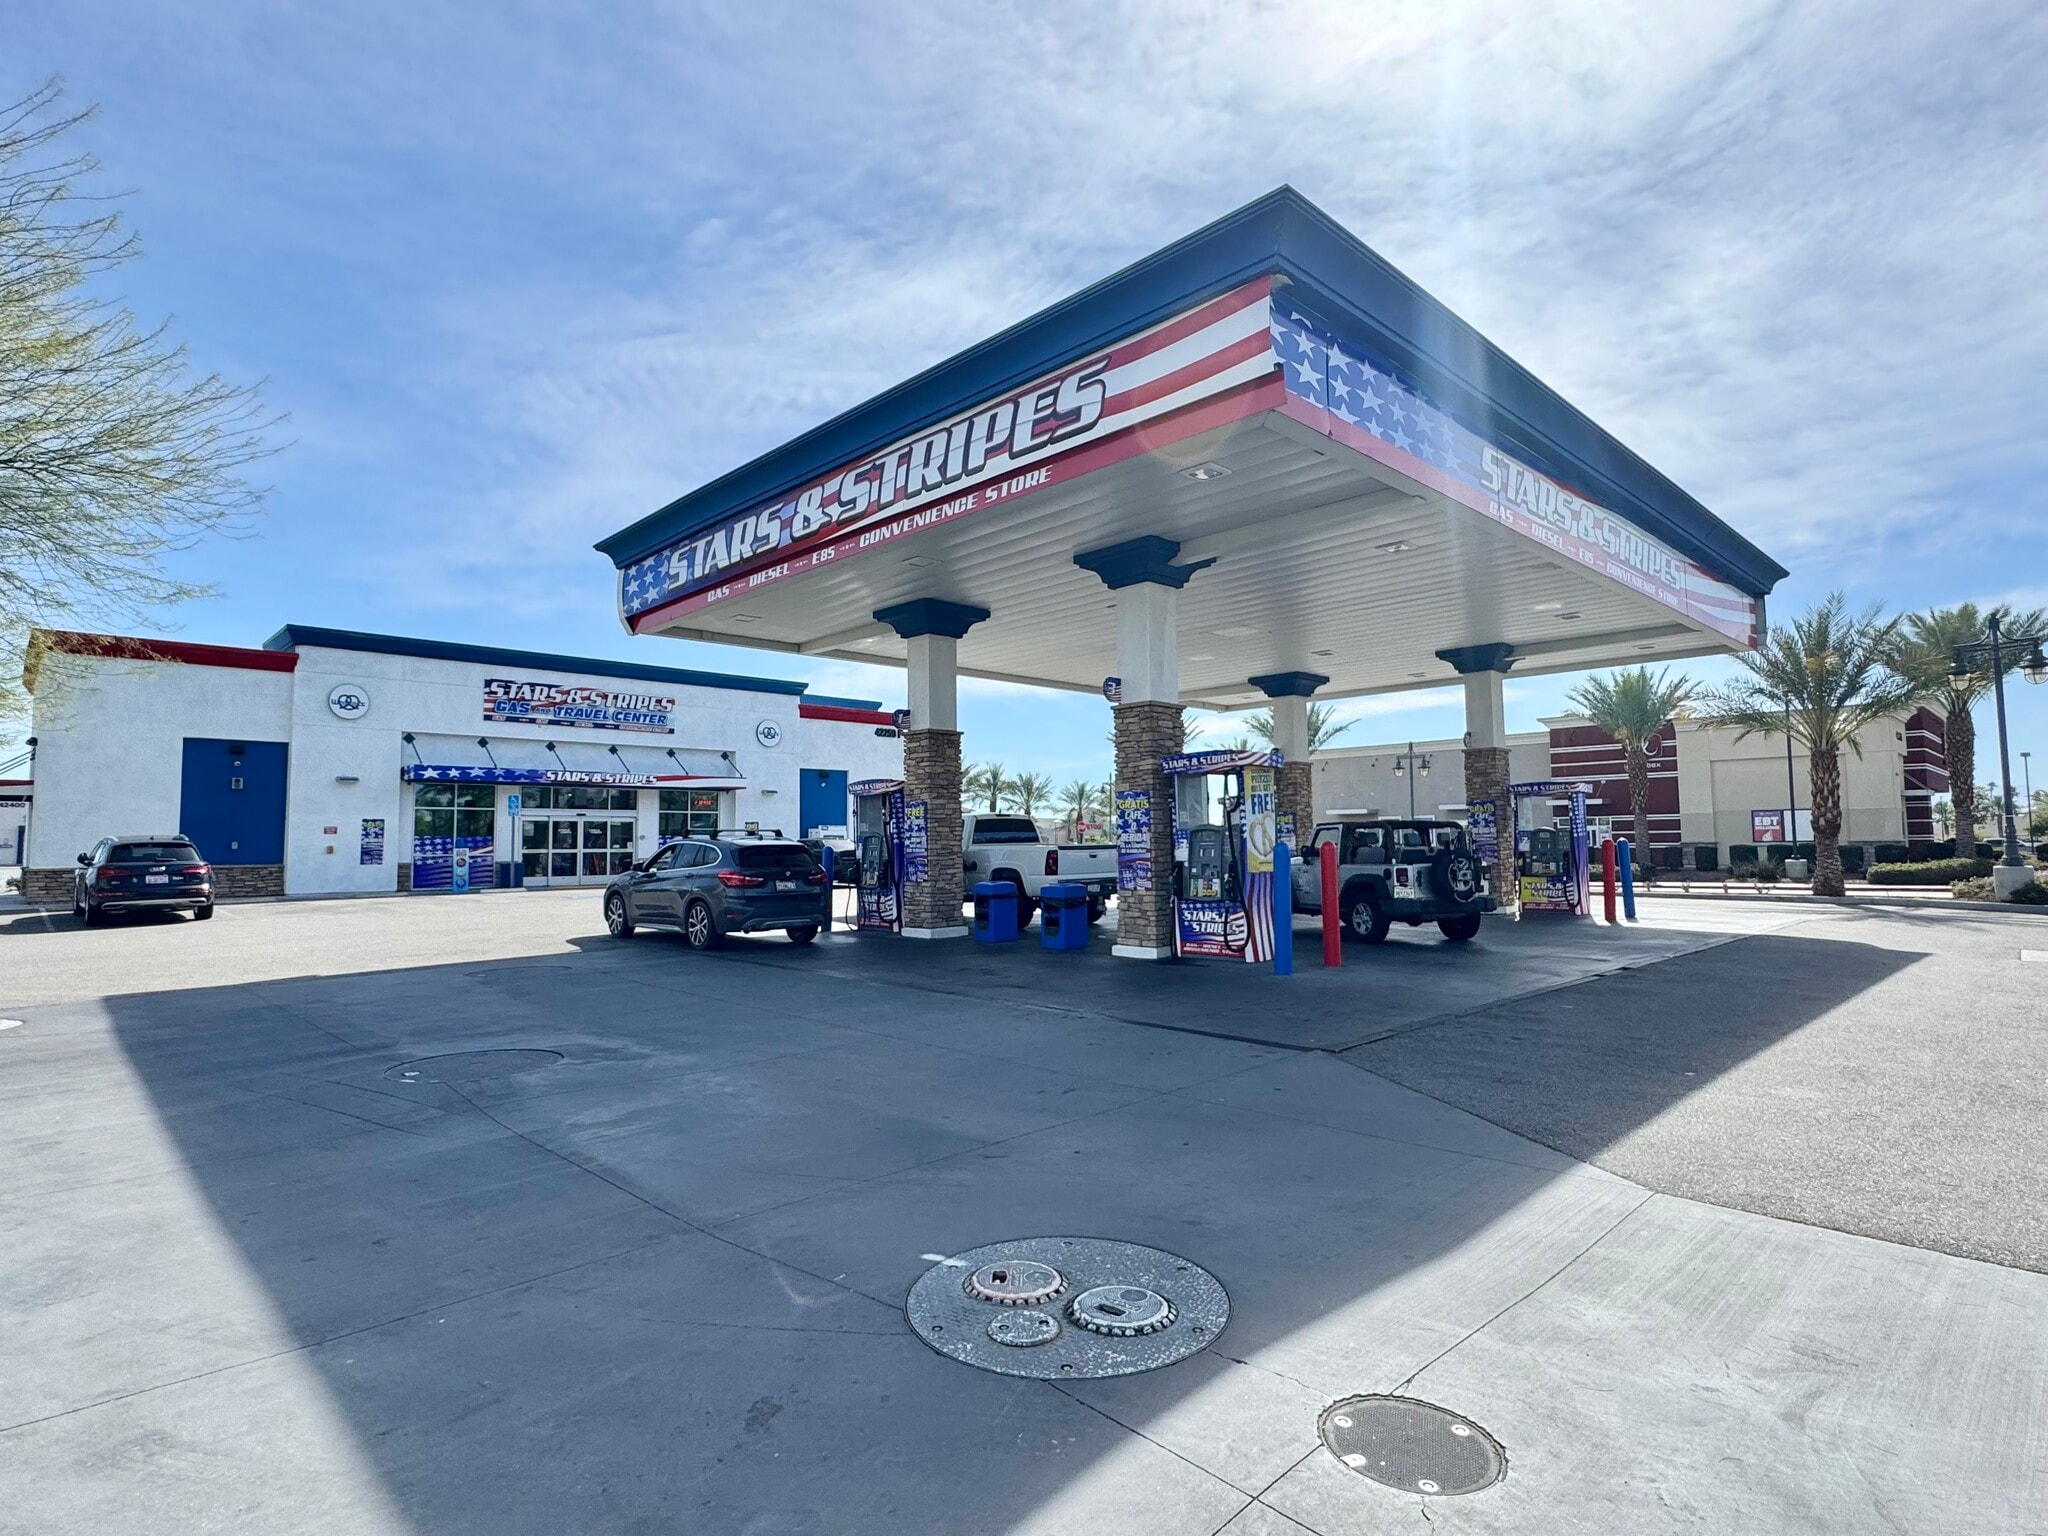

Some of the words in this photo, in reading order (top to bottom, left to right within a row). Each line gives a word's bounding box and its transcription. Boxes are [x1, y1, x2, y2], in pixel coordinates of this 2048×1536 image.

[667, 499, 785, 593] STARS
[791, 484, 831, 541] &
[837, 355, 1112, 527] STRIPES
[1480, 445, 1575, 536] STARS
[1578, 502, 1603, 546] &
[1602, 515, 1684, 591] STRIPES
[706, 583, 731, 604] GAS
[748, 562, 791, 589] DIESEL
[811, 544, 836, 567] E85
[858, 491, 980, 549] CONVENIENCE
[984, 464, 1053, 505] STORE
[1488, 500, 1514, 524] GAS
[1530, 522, 1566, 551] DIESEL
[1606, 560, 1657, 597] CONVENIENCE
[1657, 588, 1679, 608] STORE
[489, 681, 562, 704] STARS
[566, 688, 583, 705] &
[591, 690, 675, 713] STRIPES
[495, 700, 532, 715] GAS
[553, 705, 610, 721] TRAVEL
[612, 710, 668, 726] CENTER
[1162, 758, 1189, 770] STARS
[1190, 757, 1199, 767] &
[1200, 752, 1239, 765] STRIPES
[547, 770, 589, 783] STARS
[592, 771, 602, 783] &
[602, 773, 658, 785] STRIPES
[1119, 800, 1149, 810] GRATIS
[1754, 816, 1779, 826] EBT
[1184, 910, 1219, 921] STARS
